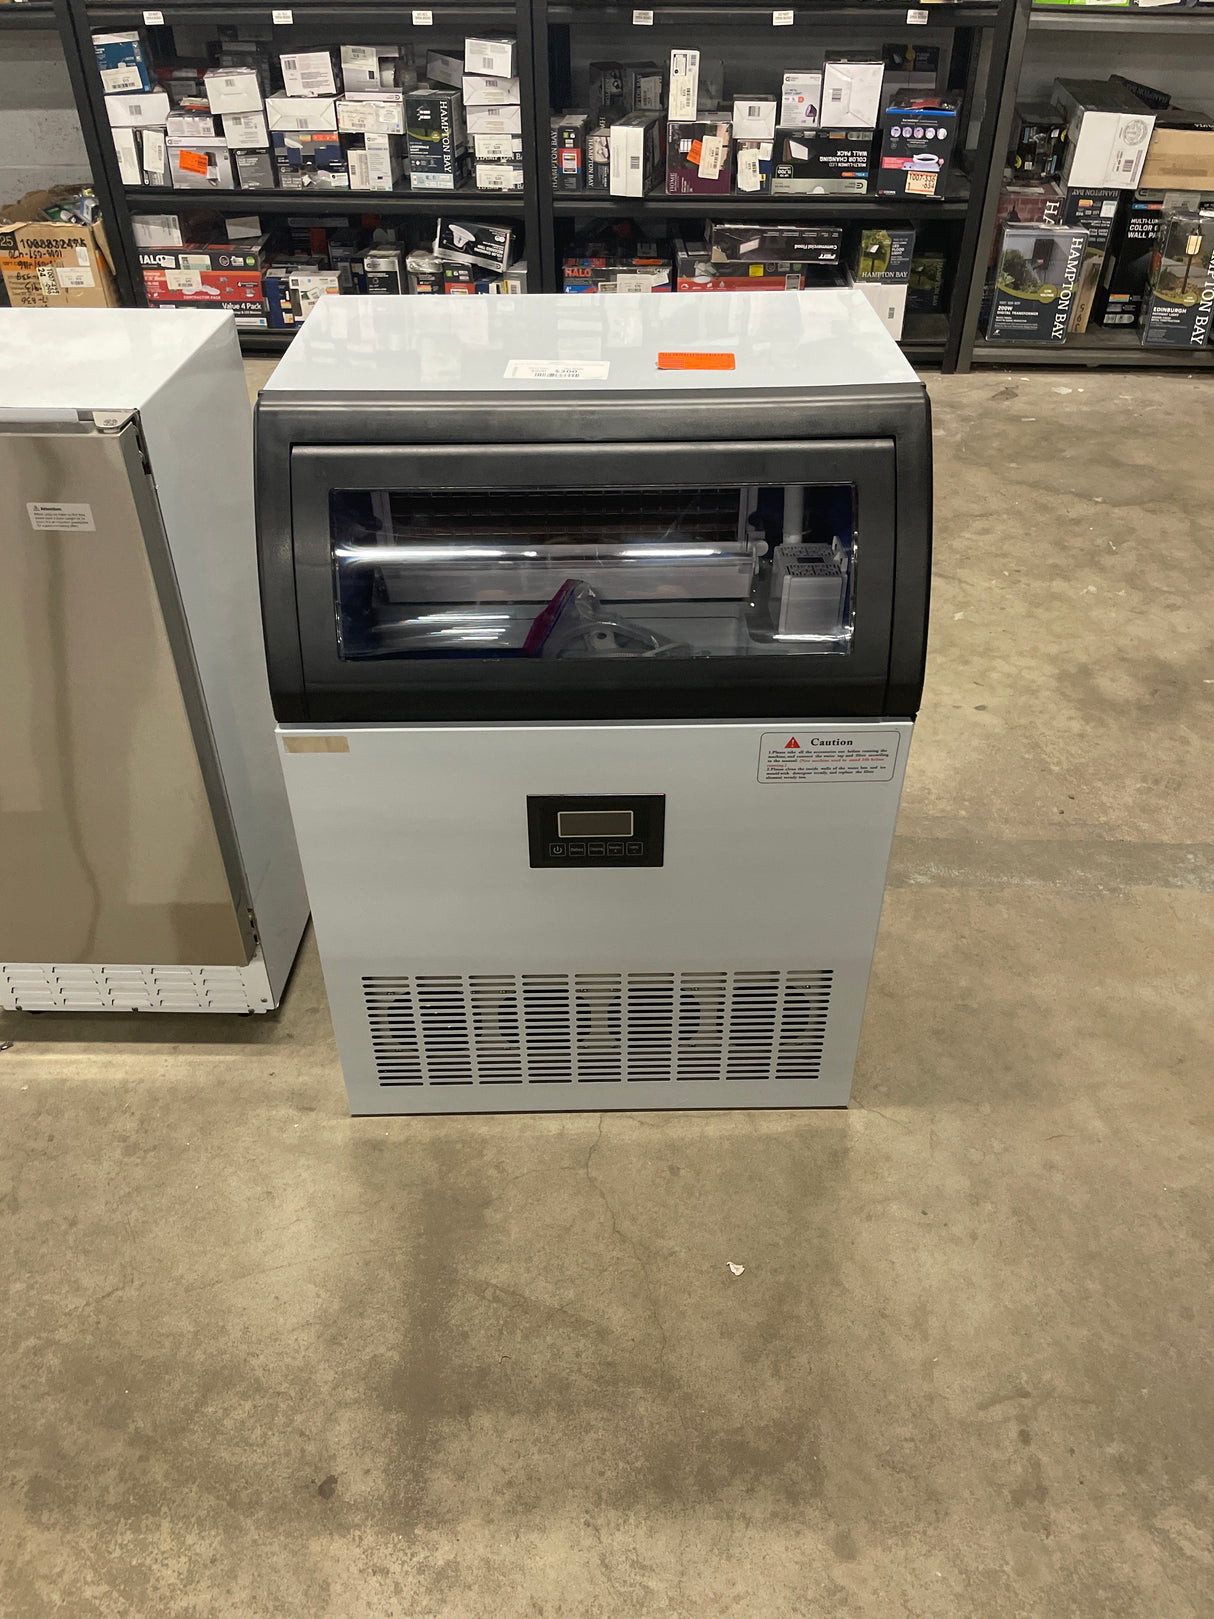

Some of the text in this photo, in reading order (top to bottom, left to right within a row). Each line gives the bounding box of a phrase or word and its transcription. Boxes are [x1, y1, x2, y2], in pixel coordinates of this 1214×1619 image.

[440, 100, 452, 173] HAMPTON BAY
[565, 268, 592, 277] HALO
[1057, 238, 1083, 310] HAMPTON
[1051, 314, 1066, 340] BAY
[1190, 316, 1208, 344] BAY
[810, 738, 853, 746] Caution
